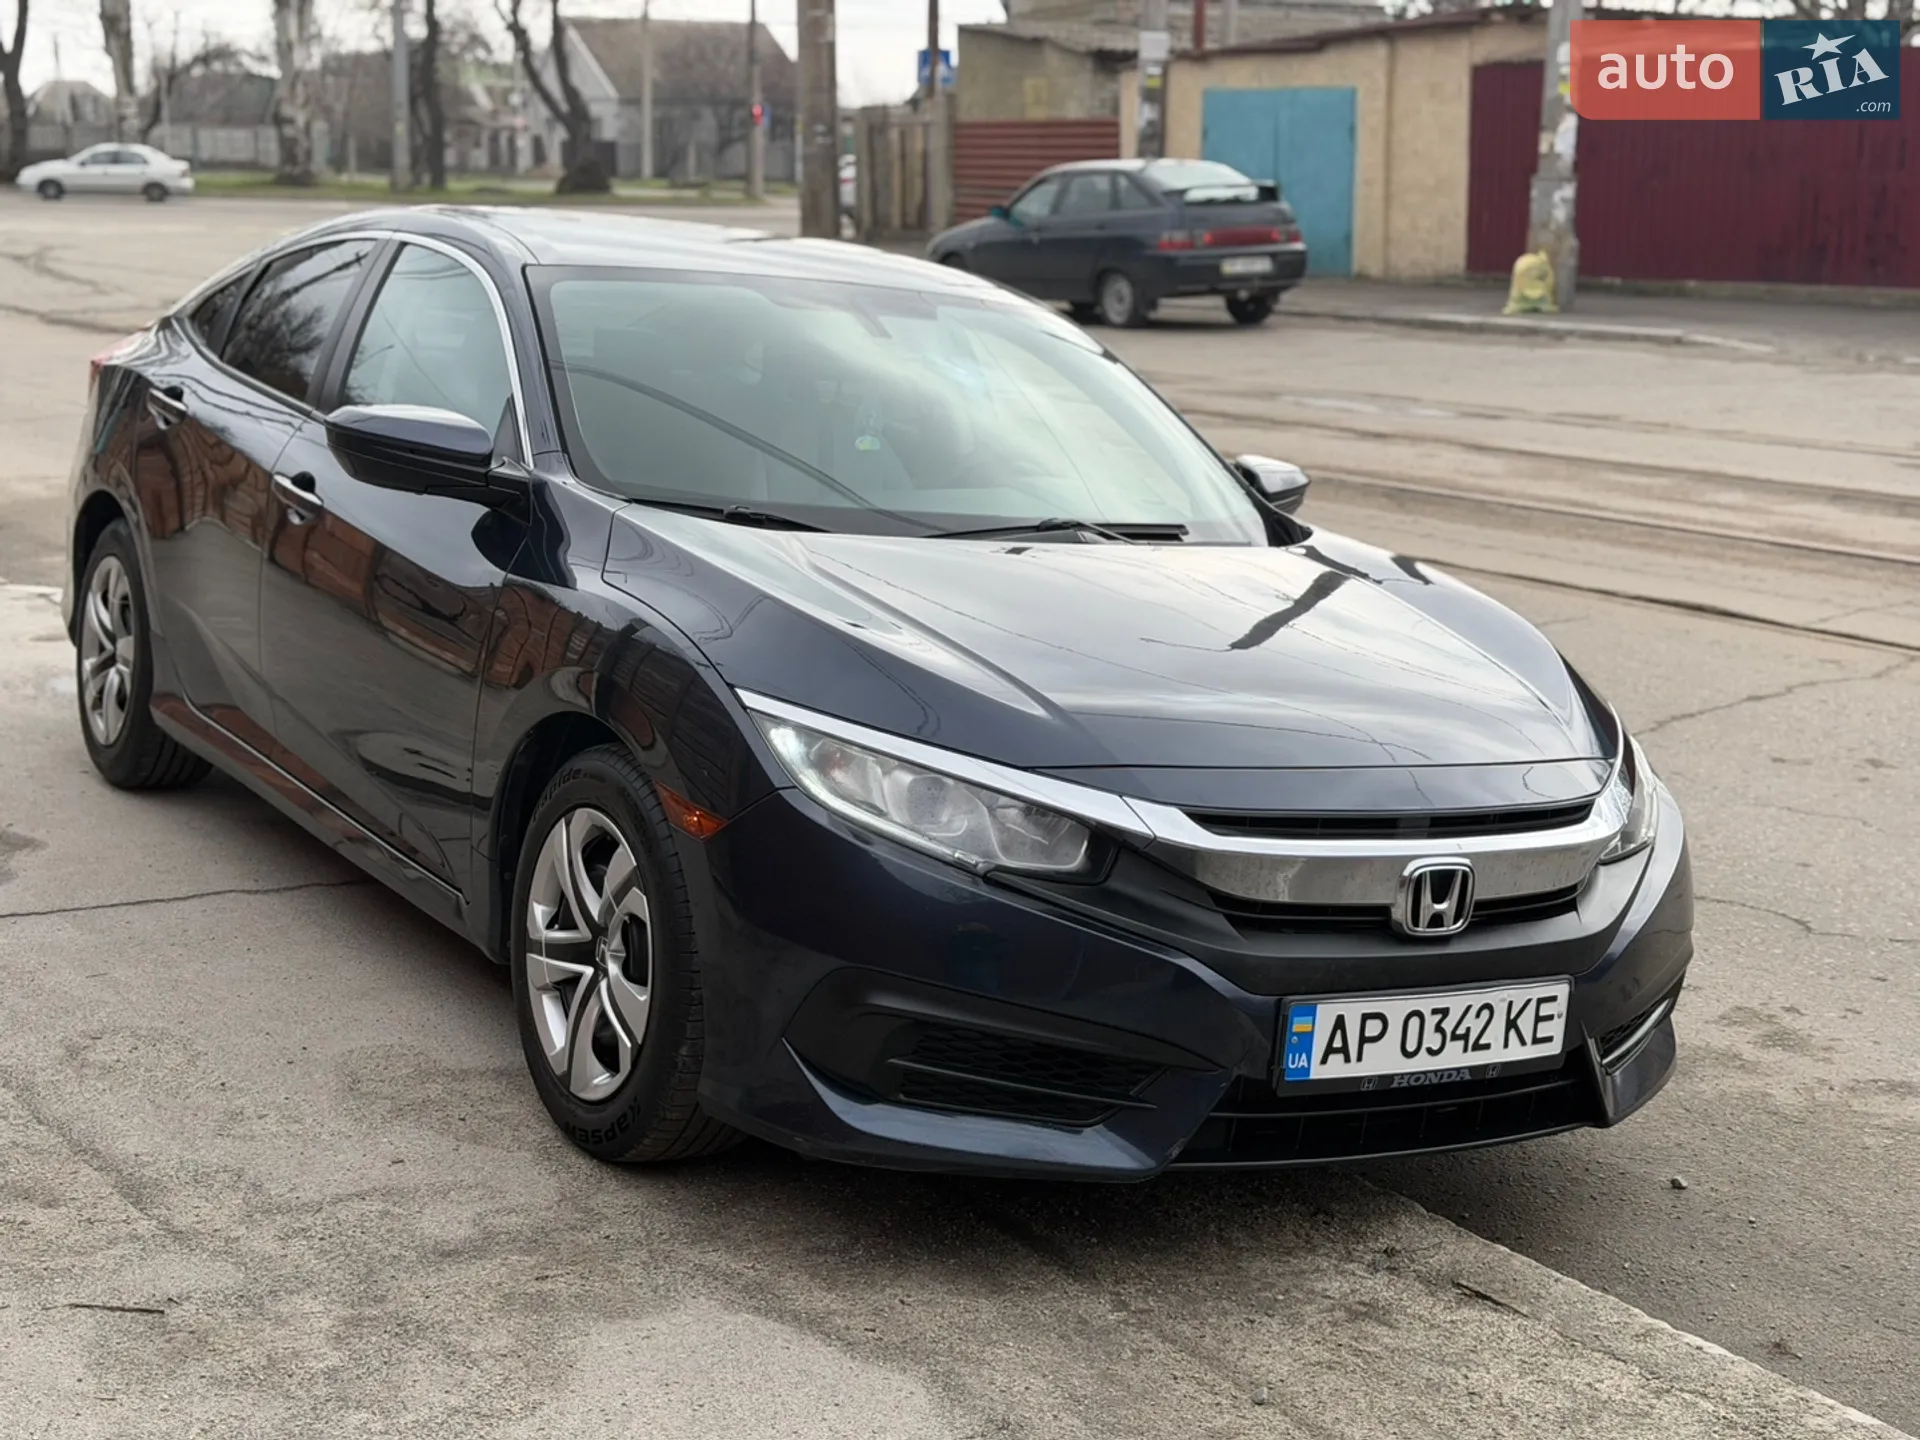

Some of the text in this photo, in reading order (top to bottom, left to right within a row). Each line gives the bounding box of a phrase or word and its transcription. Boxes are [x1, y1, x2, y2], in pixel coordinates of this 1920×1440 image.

[1319, 994, 1559, 1066] AP 0342 KE
[1287, 1052, 1309, 1069] UA
[1389, 1068, 1472, 1089] HONDA
